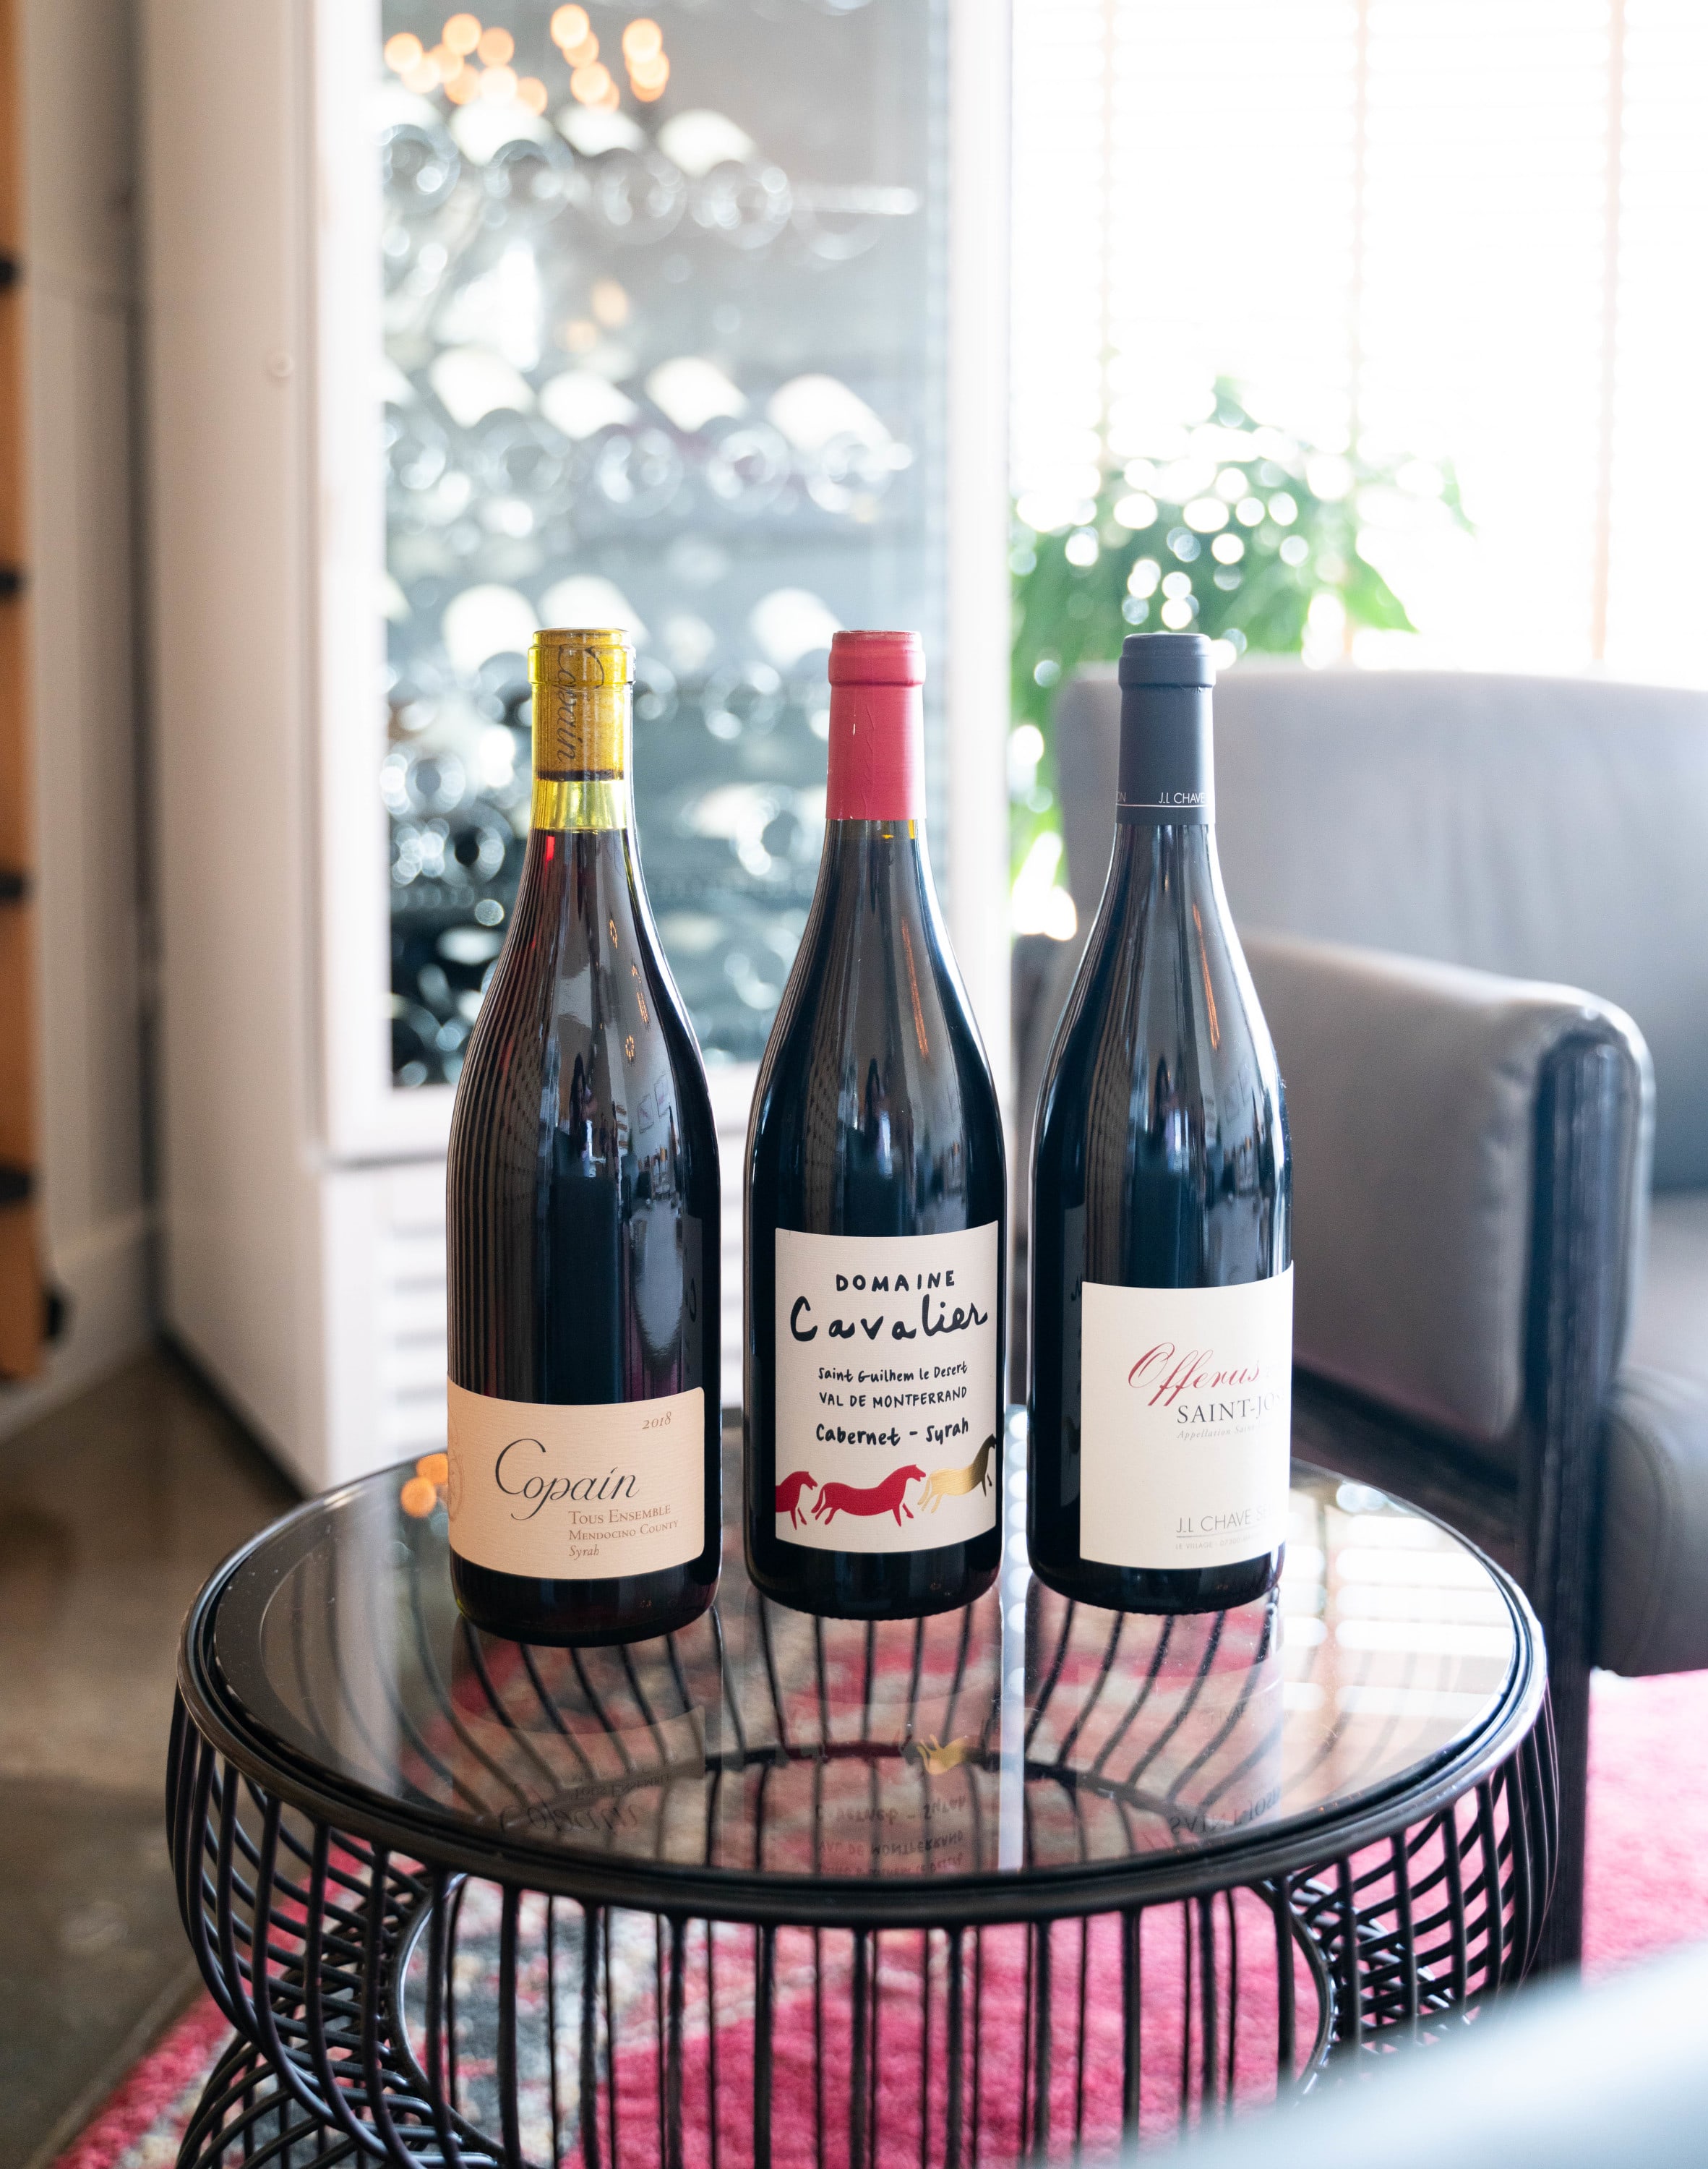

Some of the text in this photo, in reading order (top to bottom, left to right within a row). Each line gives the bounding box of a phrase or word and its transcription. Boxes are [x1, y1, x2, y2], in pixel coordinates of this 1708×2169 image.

[1173, 792, 1206, 804] CHAVE
[836, 1269, 956, 1292] DOMAINE
[789, 1293, 989, 1342] Cavalier
[817, 1361, 969, 1384] Saint Guilhem le Desert
[818, 1386, 968, 1408] VAL DE MONTFERRAND
[641, 1411, 672, 1429] 2018
[815, 1423, 901, 1447] Cabernet
[925, 1417, 970, 1445] Syrah
[1177, 1429, 1231, 1441] Appellation
[494, 1437, 640, 1521] Copain
[1201, 1508, 1251, 1532] CHAVE
[568, 1544, 601, 1560] Syrah
